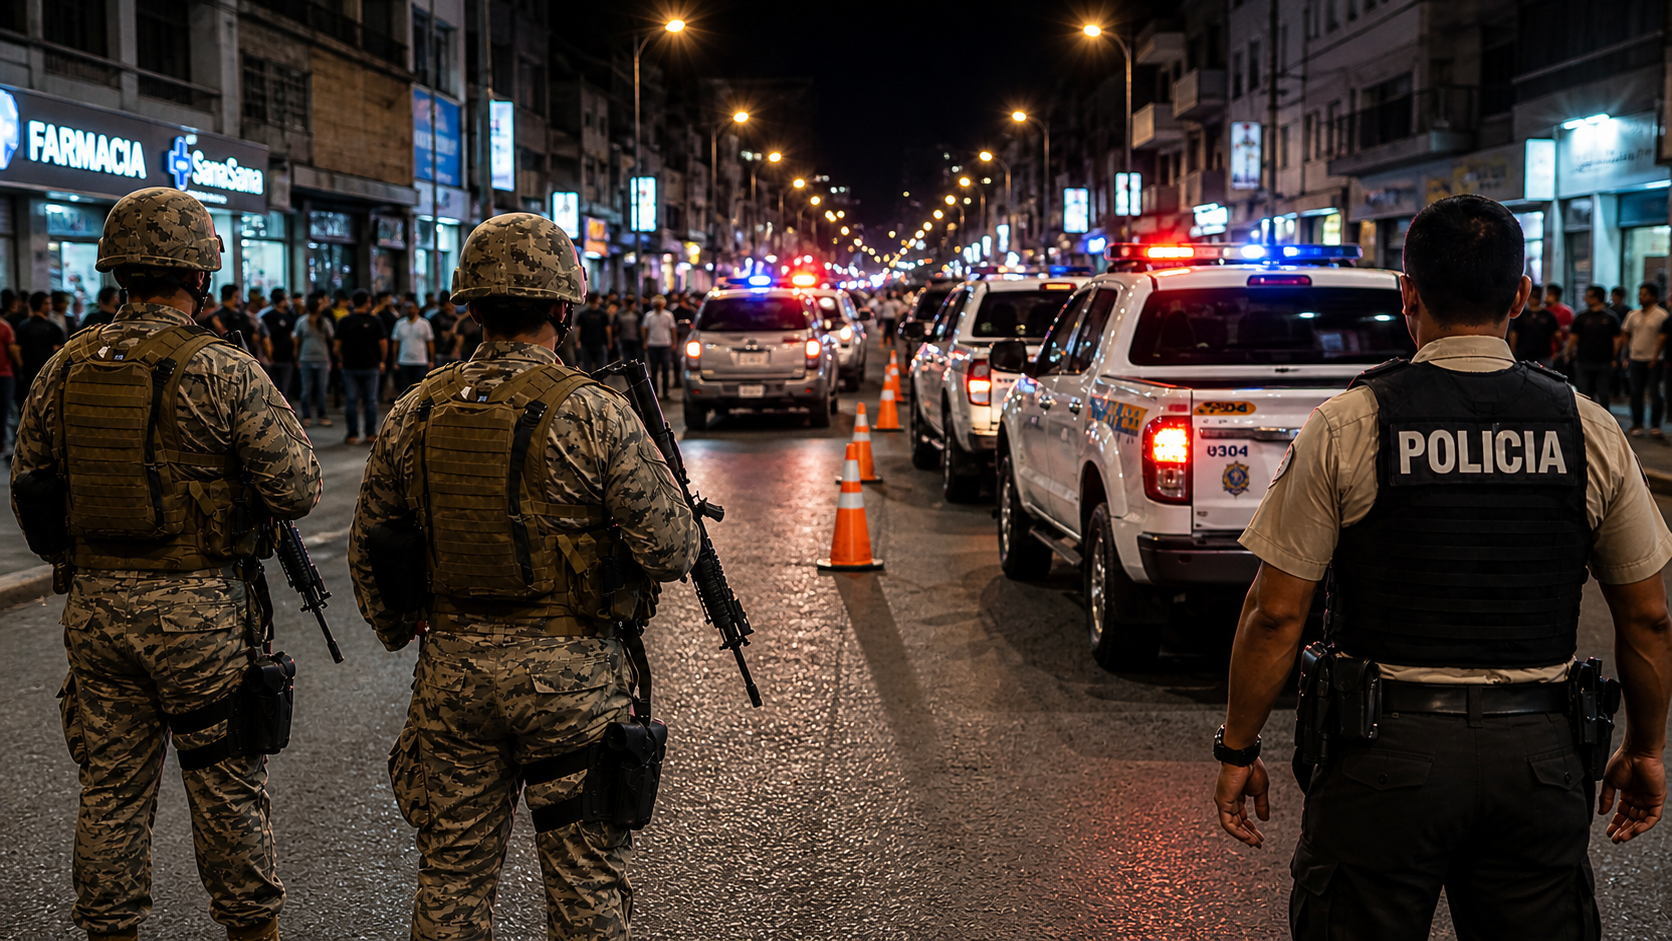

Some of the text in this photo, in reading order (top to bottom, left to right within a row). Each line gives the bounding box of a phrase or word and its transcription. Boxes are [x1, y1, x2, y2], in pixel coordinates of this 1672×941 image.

[28, 119, 147, 180] FARMACIA
[191, 149, 264, 196] SanaSana
[1398, 429, 1568, 475] POLICIA
